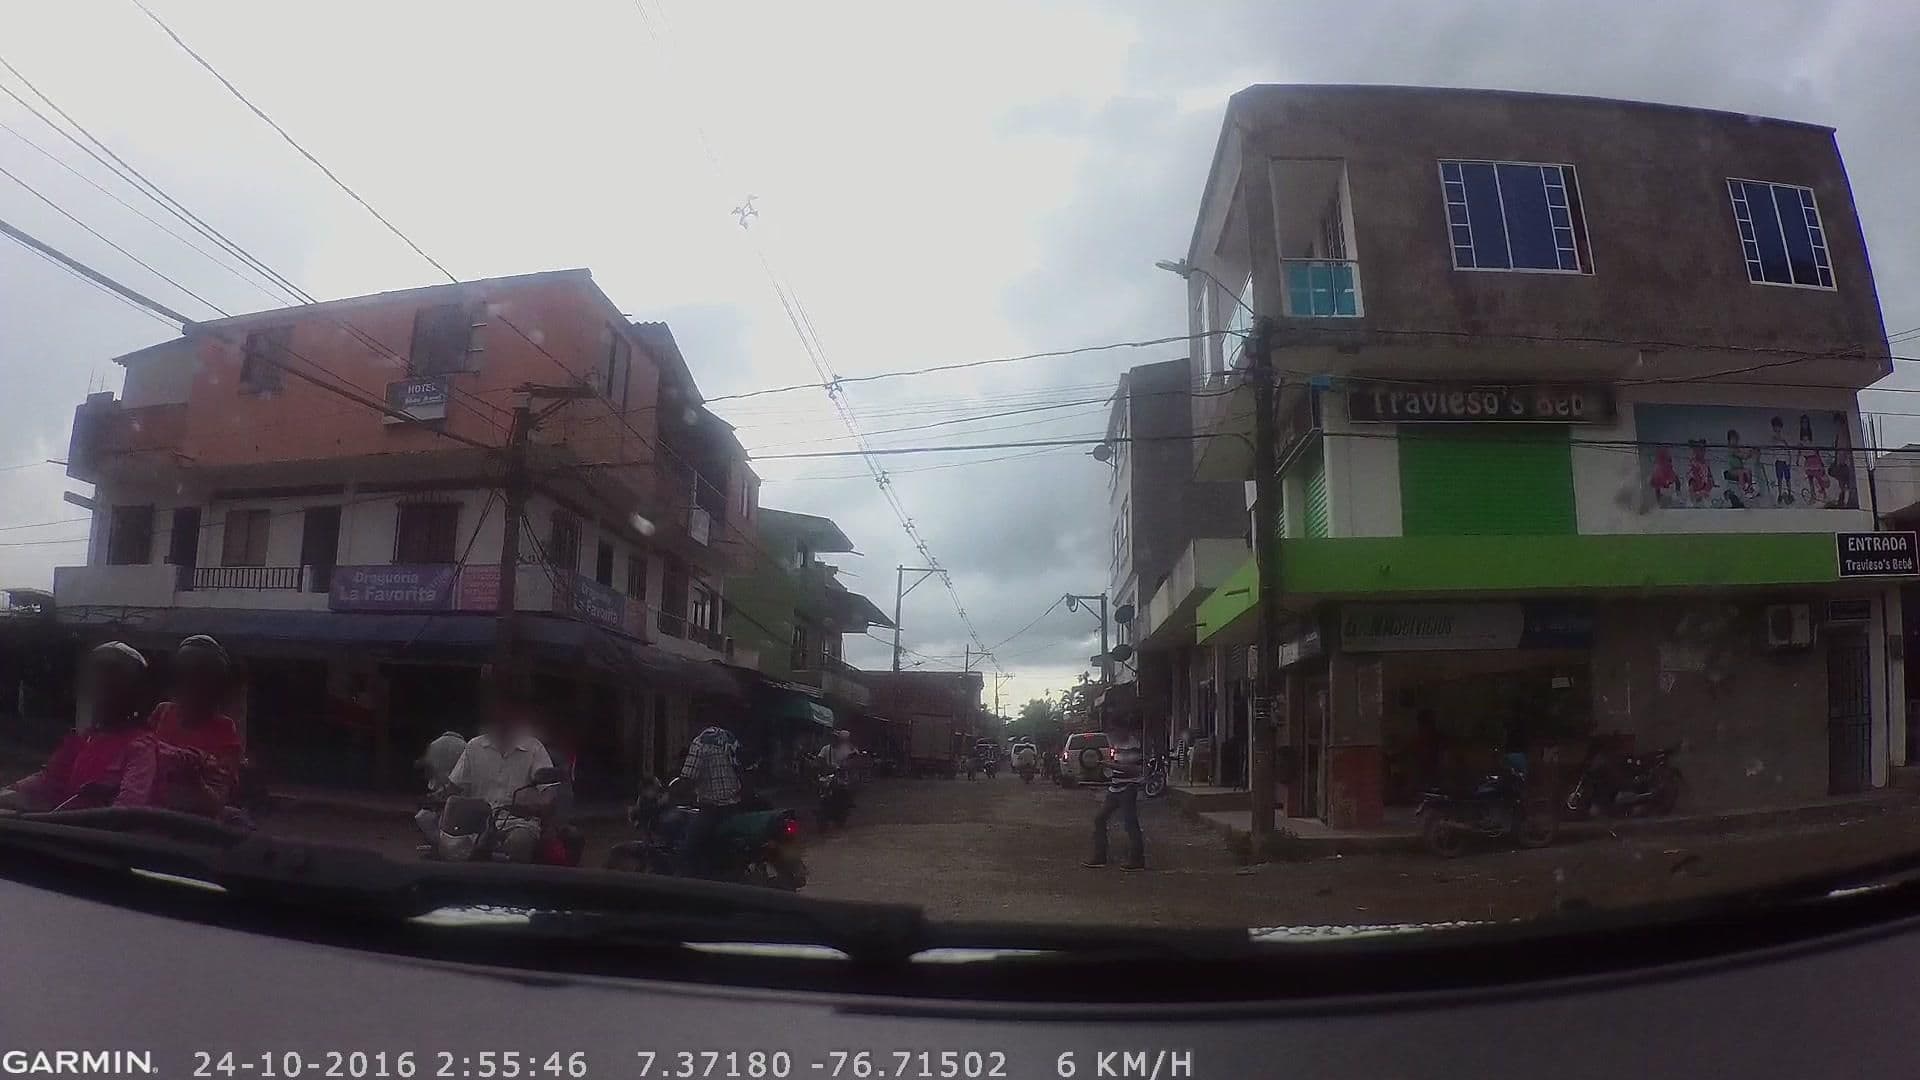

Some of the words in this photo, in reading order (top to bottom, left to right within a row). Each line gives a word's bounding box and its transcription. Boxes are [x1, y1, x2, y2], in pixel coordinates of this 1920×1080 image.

[407, 383, 436, 394] HOTEL
[1848, 537, 1907, 551] ENTRADA
[1845, 558, 1890, 571] Travieso's
[340, 586, 359, 601] La
[364, 586, 437, 602] Favorita
